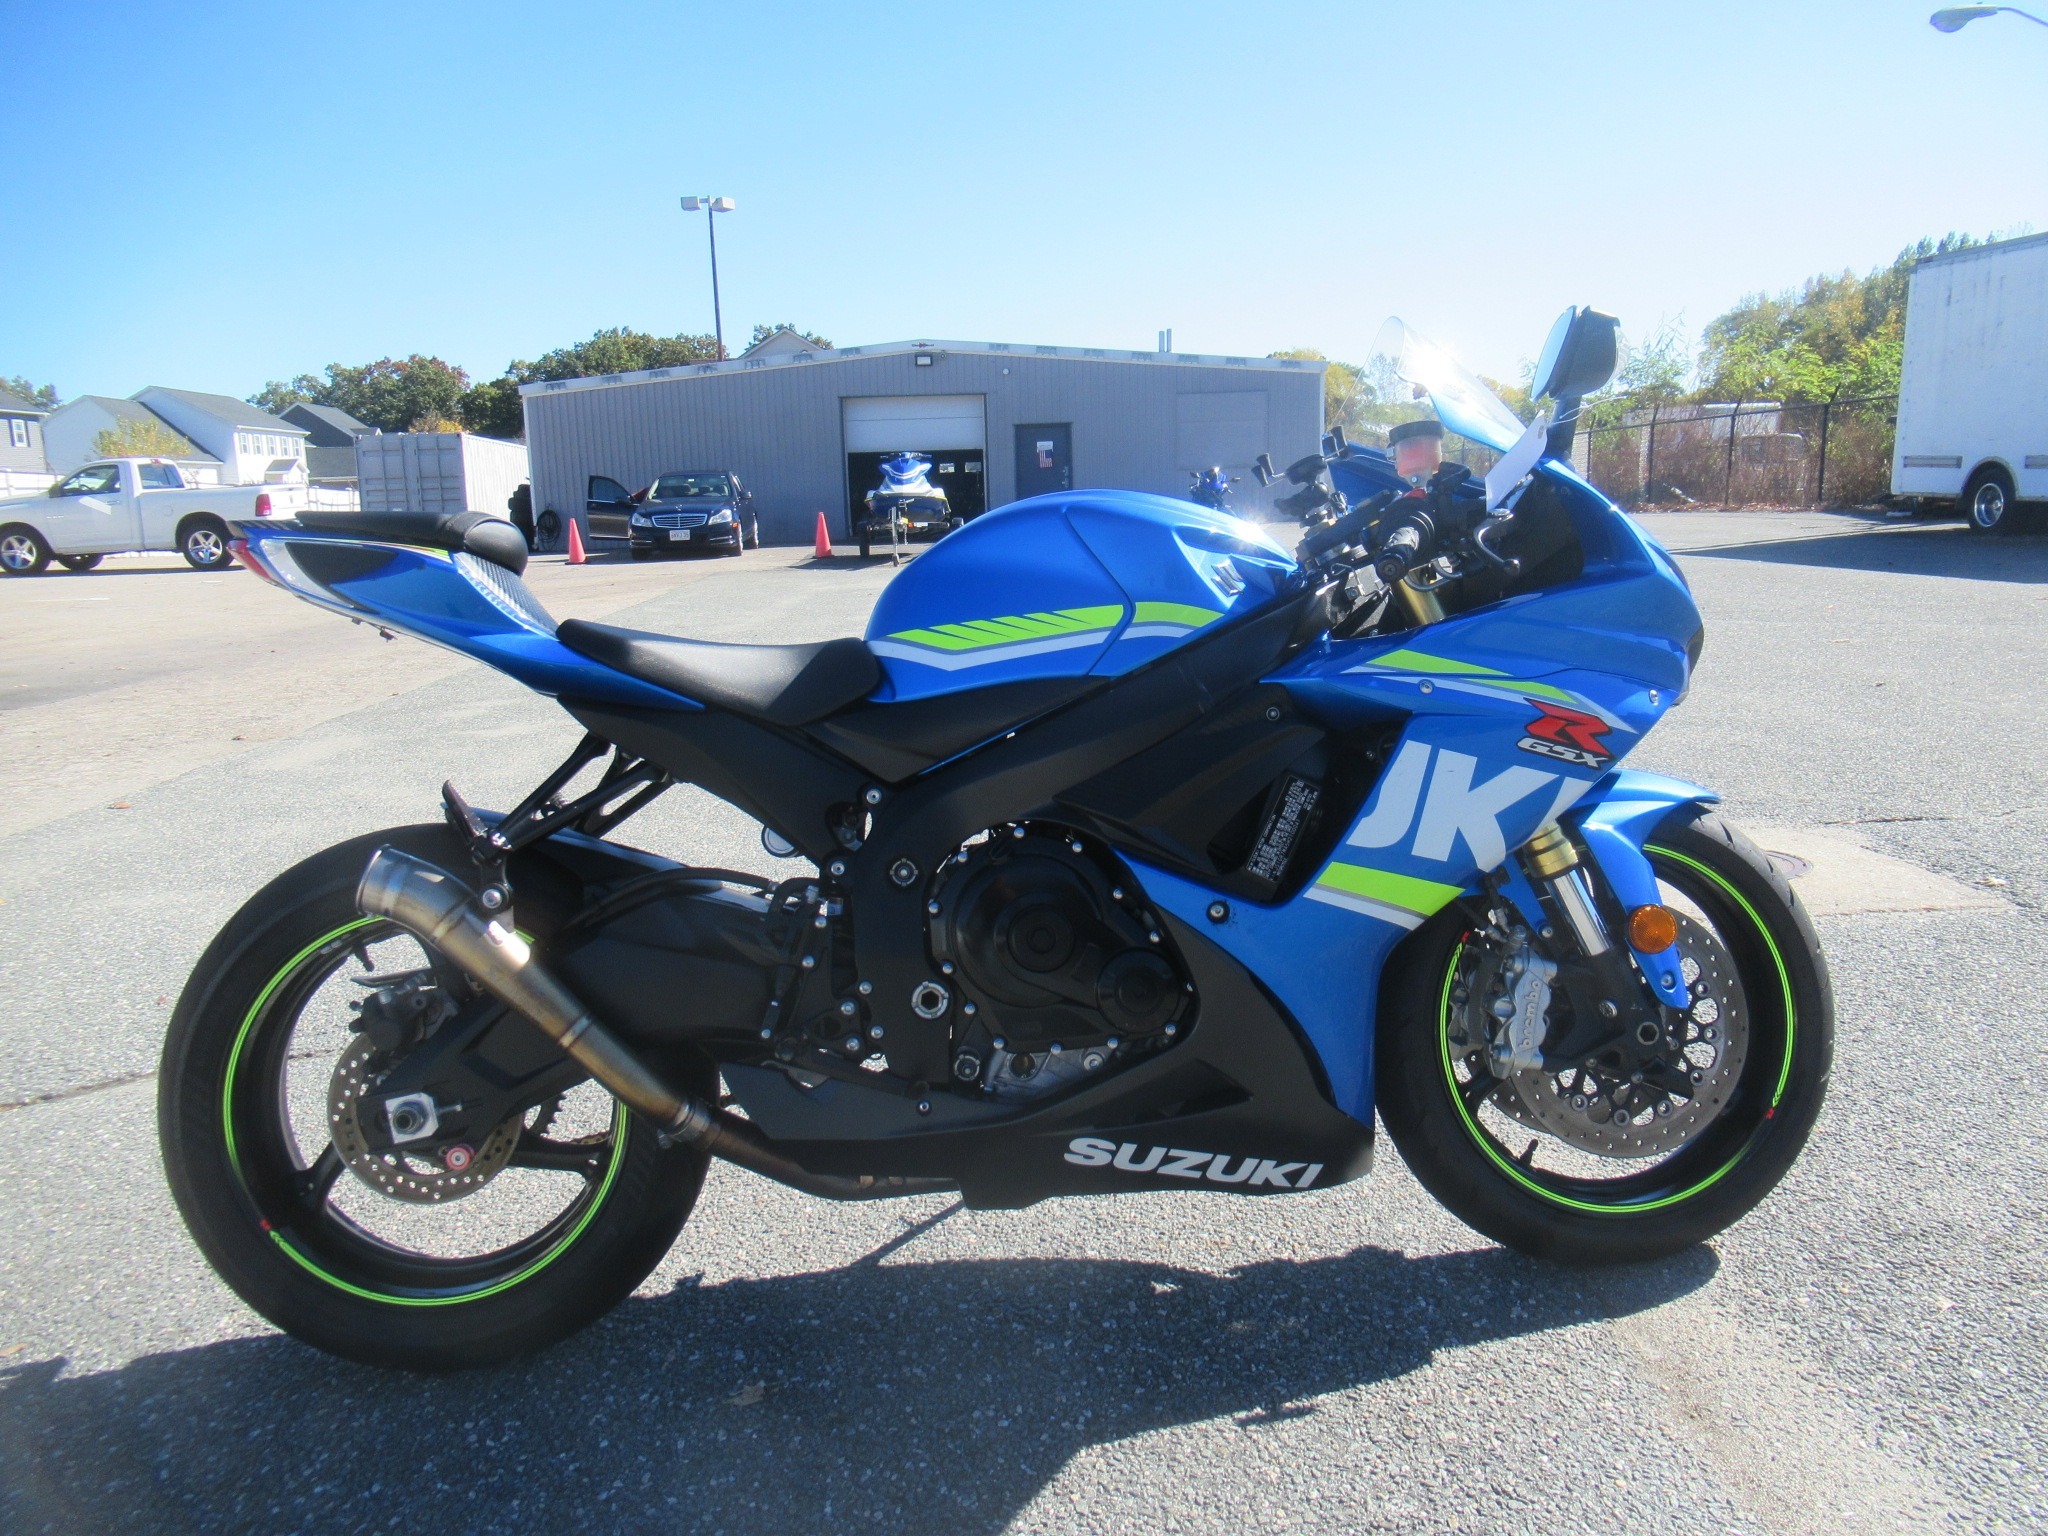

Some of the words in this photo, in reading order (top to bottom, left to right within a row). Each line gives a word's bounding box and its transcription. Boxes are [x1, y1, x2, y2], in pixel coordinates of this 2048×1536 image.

[1516, 736, 1609, 769] GSX
[1518, 980, 1540, 1048] brembo
[1063, 1137, 1324, 1188] SUZUKI
